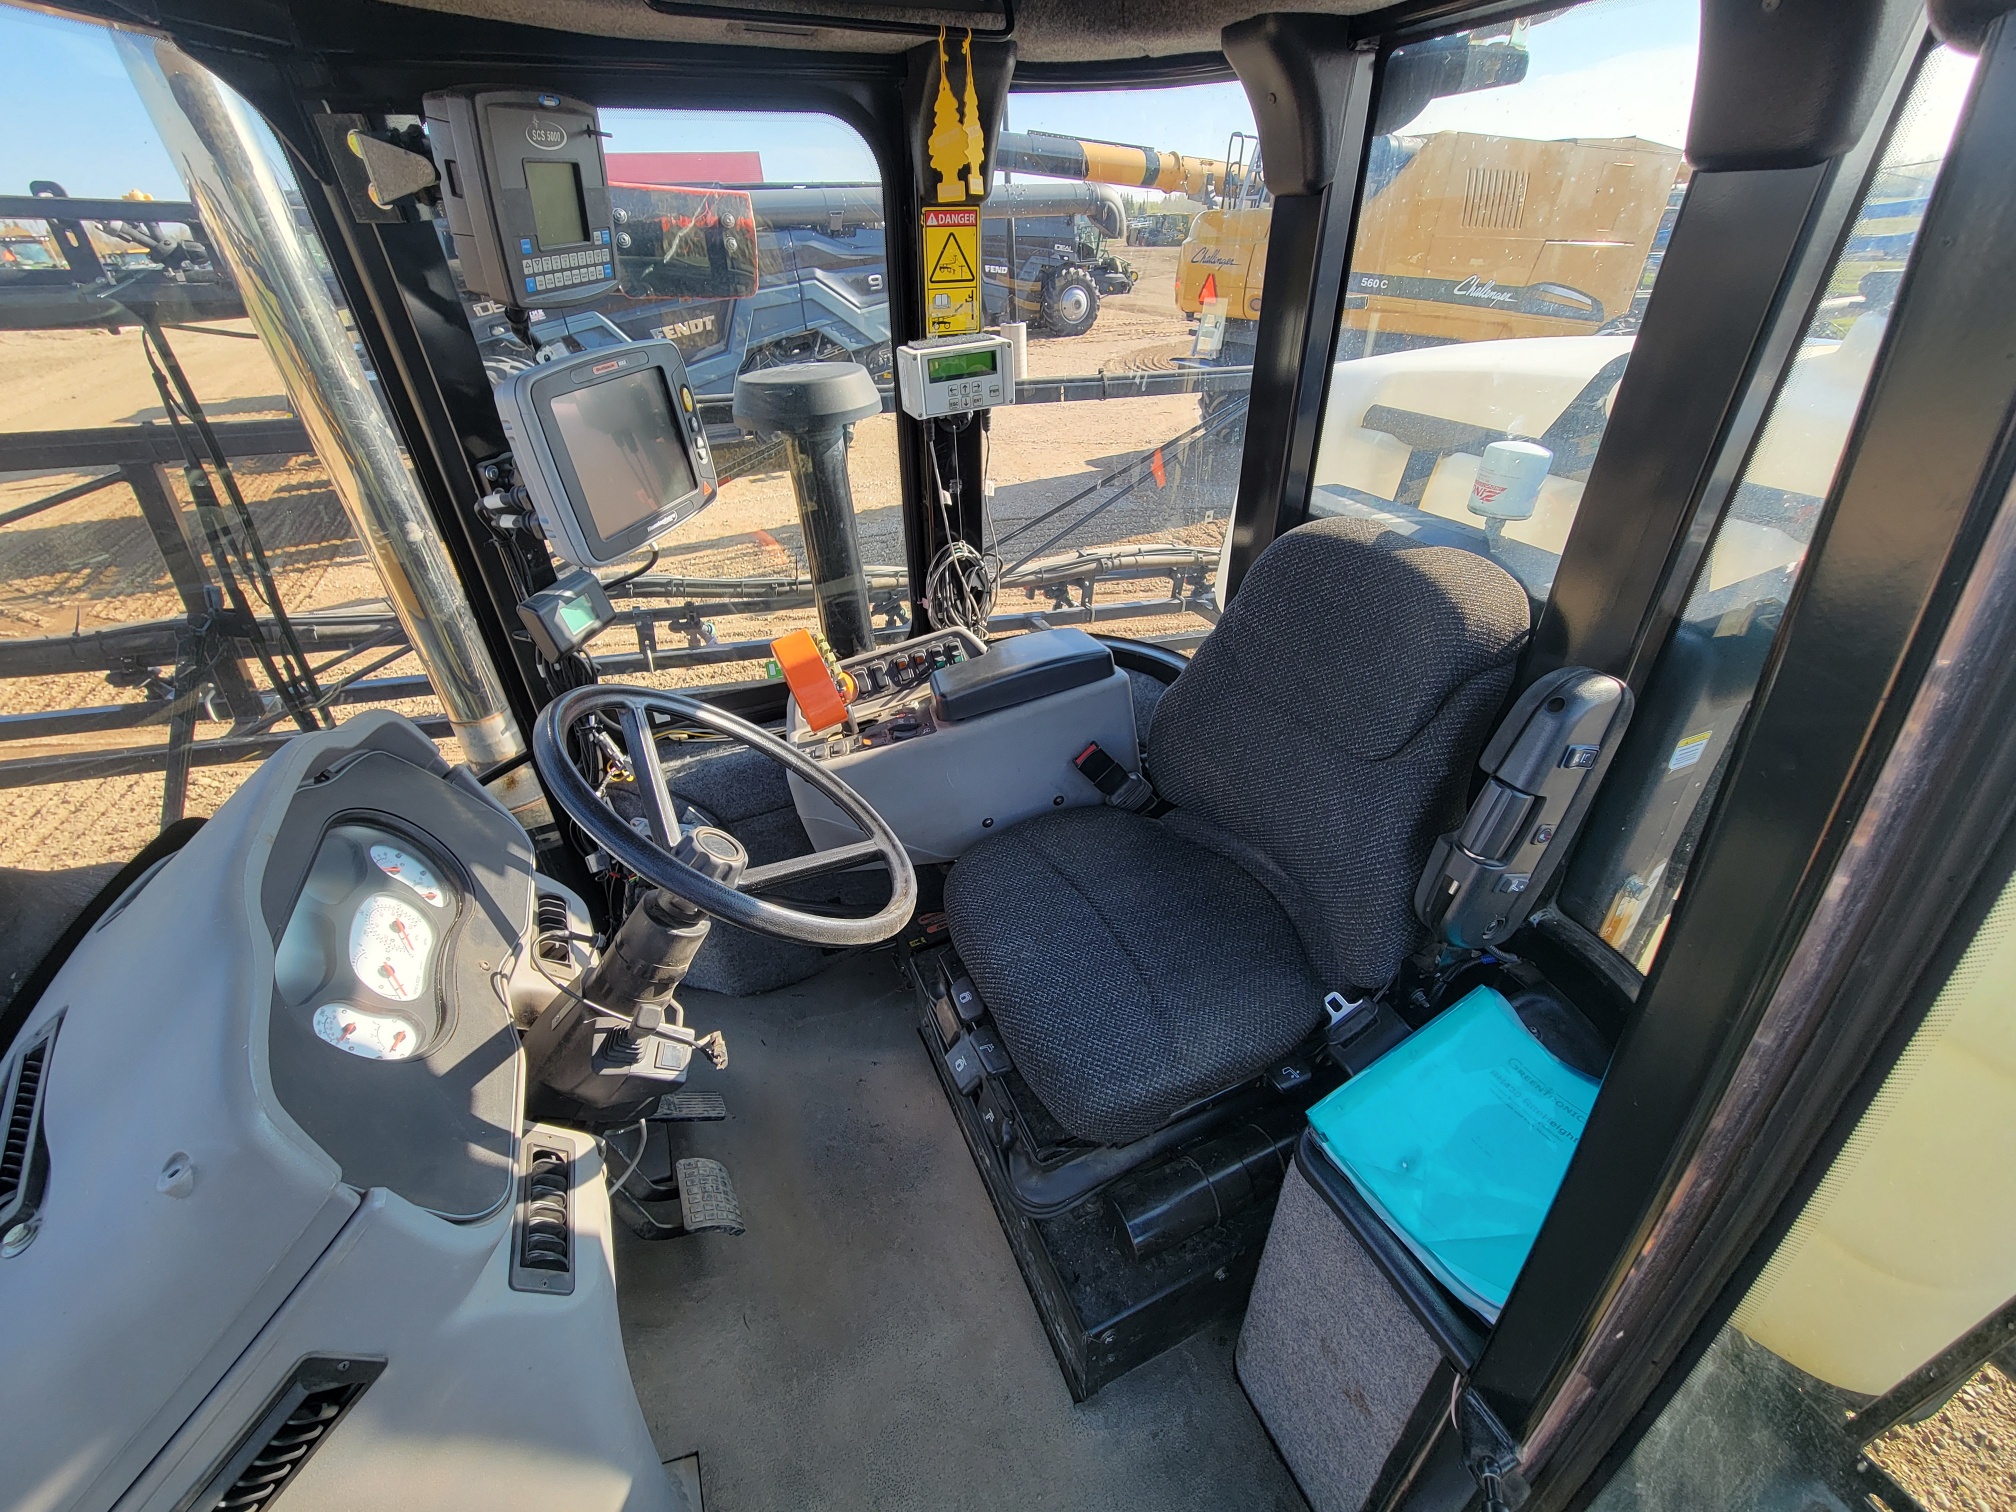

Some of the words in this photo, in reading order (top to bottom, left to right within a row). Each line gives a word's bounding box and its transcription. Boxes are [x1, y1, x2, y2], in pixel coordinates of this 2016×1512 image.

[532, 129, 546, 141] SCS
[546, 130, 561, 142] 5000
[938, 213, 976, 225] DANGER
[1054, 243, 1074, 253] IDEAL
[1191, 246, 1241, 271] Challenger
[984, 264, 1008, 274] FEND
[1453, 274, 1518, 307] Challenger
[649, 315, 715, 340] FENDT
[1508, 1058, 1586, 1124] GREENTRONIC
